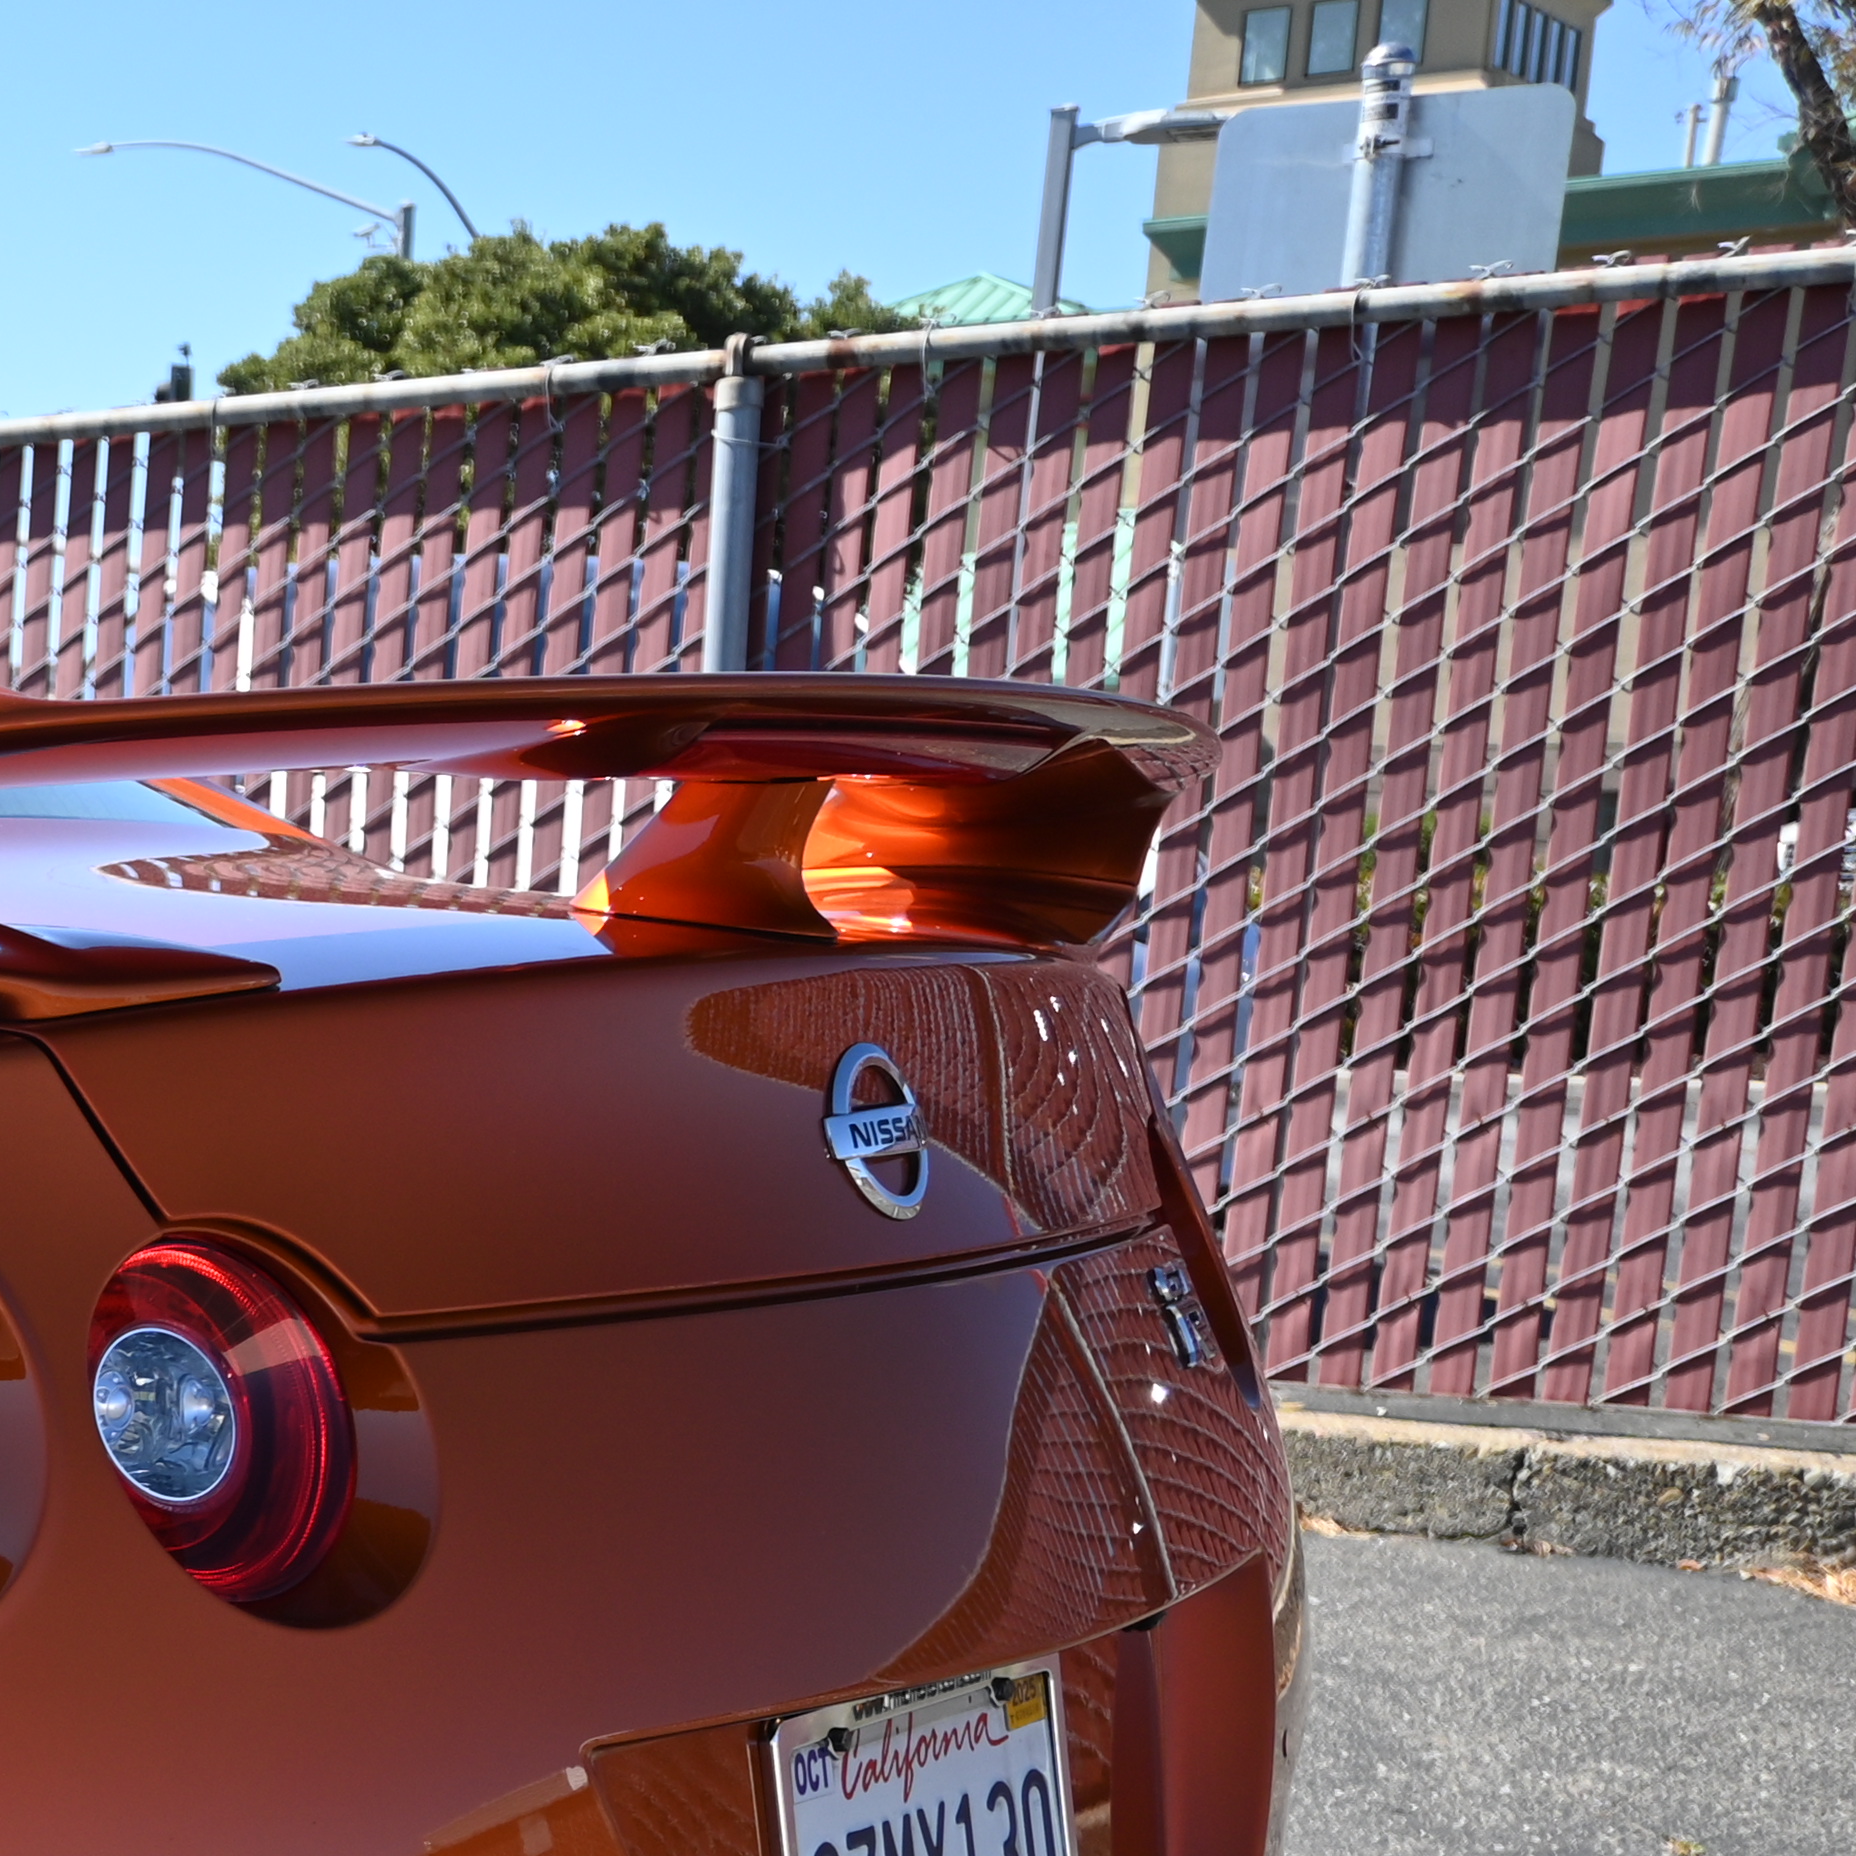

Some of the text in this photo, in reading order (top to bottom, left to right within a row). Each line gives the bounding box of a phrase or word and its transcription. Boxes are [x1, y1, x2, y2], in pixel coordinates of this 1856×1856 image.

[849, 1115, 928, 1149] NISSAN
[794, 1712, 1009, 1803] OCT California
